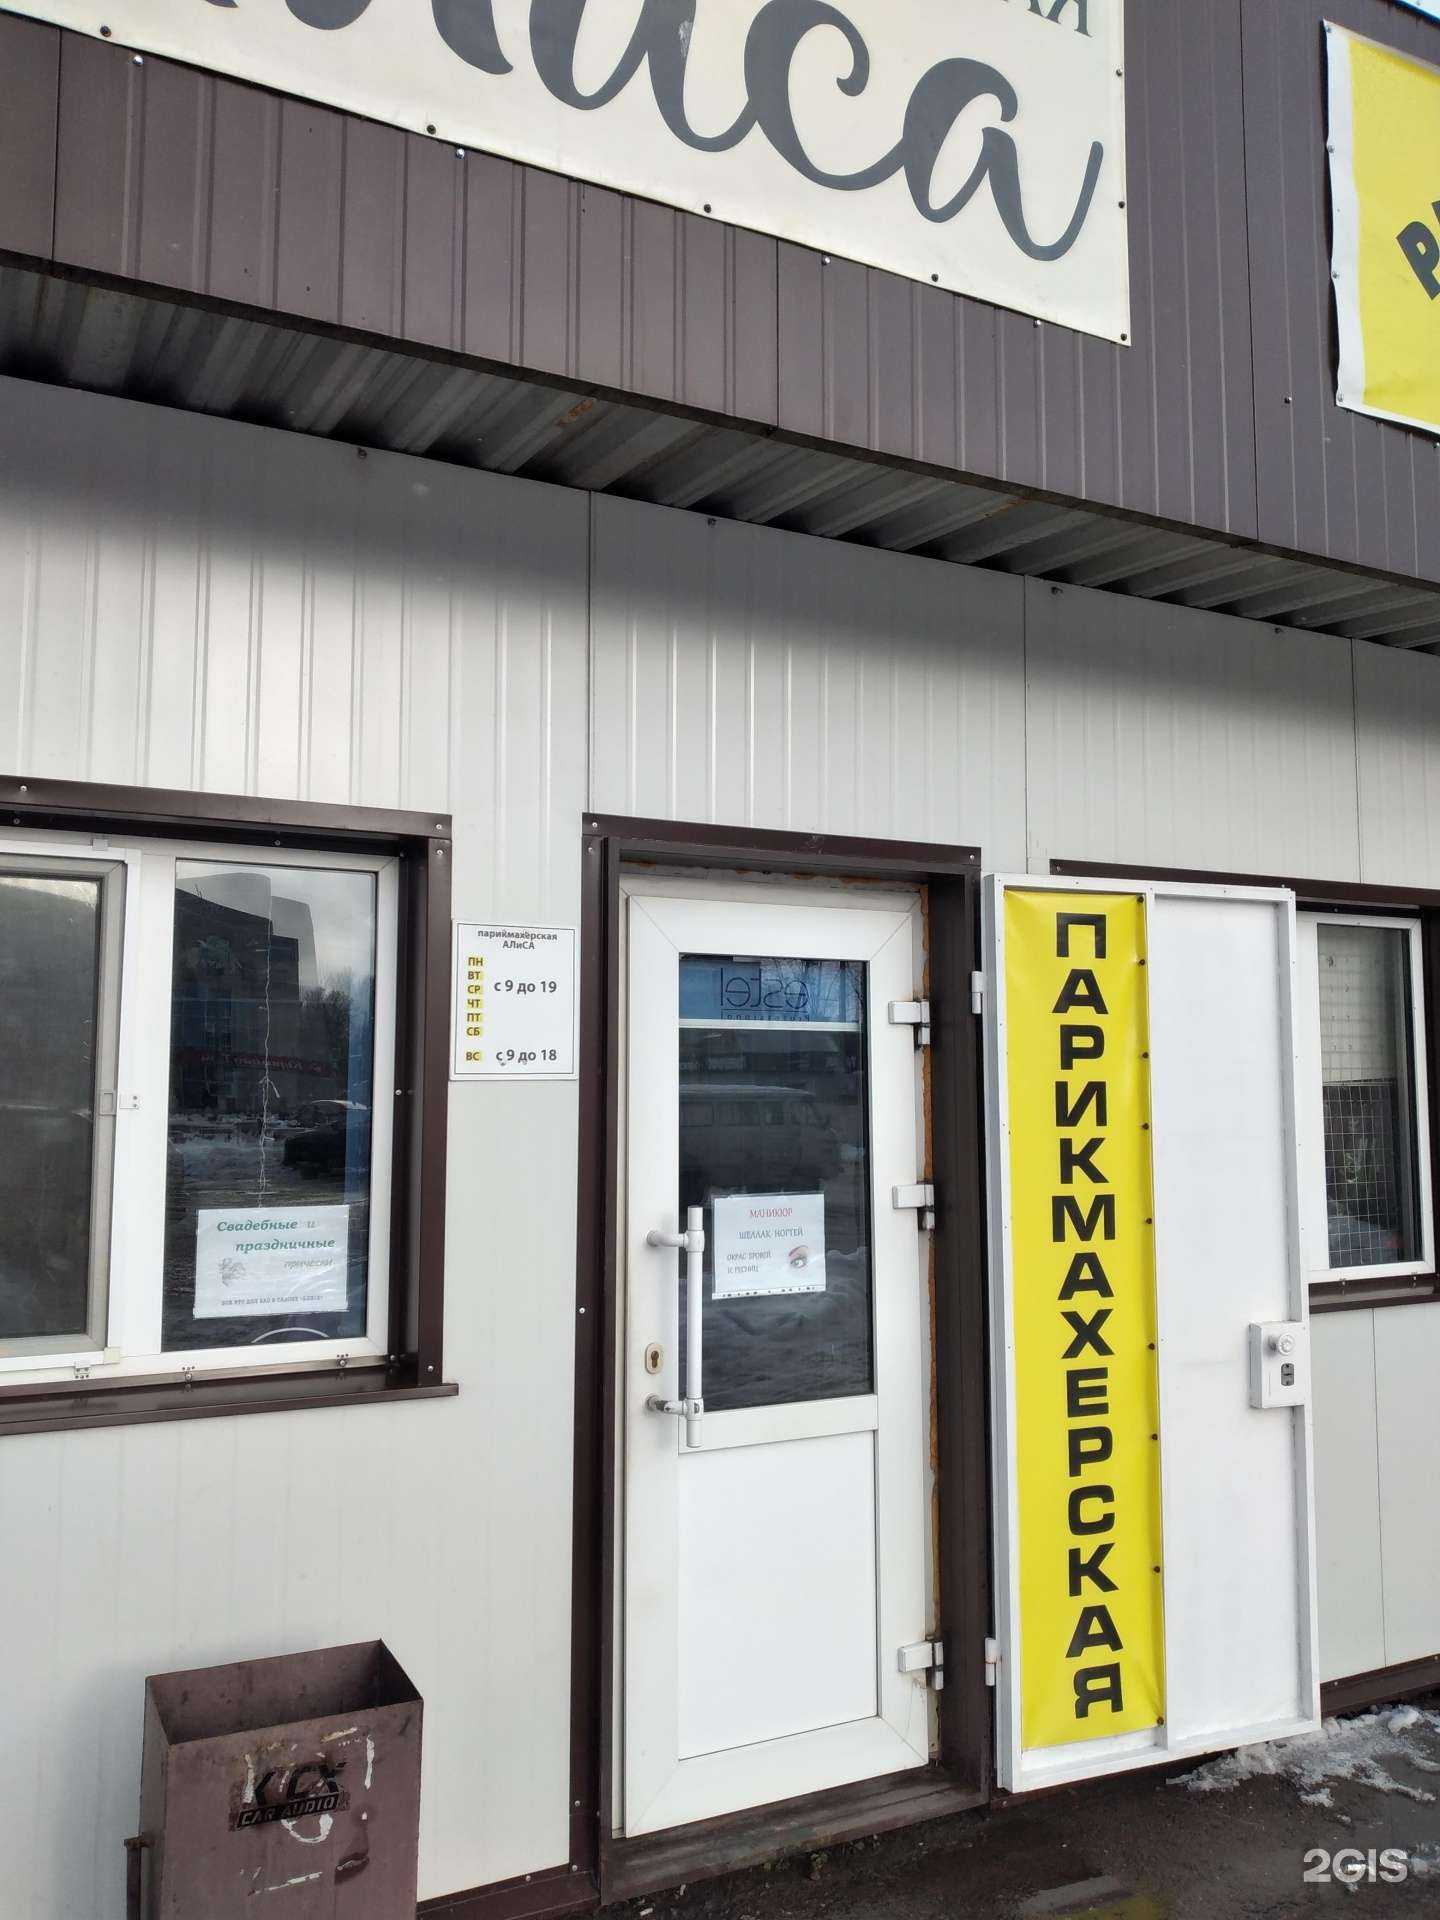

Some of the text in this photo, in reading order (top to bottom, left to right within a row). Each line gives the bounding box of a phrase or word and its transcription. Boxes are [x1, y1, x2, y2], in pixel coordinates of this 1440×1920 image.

[468, 957, 483, 967] ПН
[467, 971, 481, 980] ВТ
[467, 980, 557, 995] СР с 9 до 19
[467, 999, 481, 1008] ЧТ
[466, 1013, 481, 1022] ПТ
[466, 1027, 480, 1036] СБ
[466, 1050, 557, 1063] ВС с 9 до 18
[750, 1208, 793, 1218] МАНИКЮР
[217, 1220, 298, 1232] Свадебные
[235, 1239, 335, 1254] праздничные
[1052, 912, 1124, 1719] ПАРИКМАХЕРСКАЯ
[241, 1796, 335, 1826] CAR AUDIO
